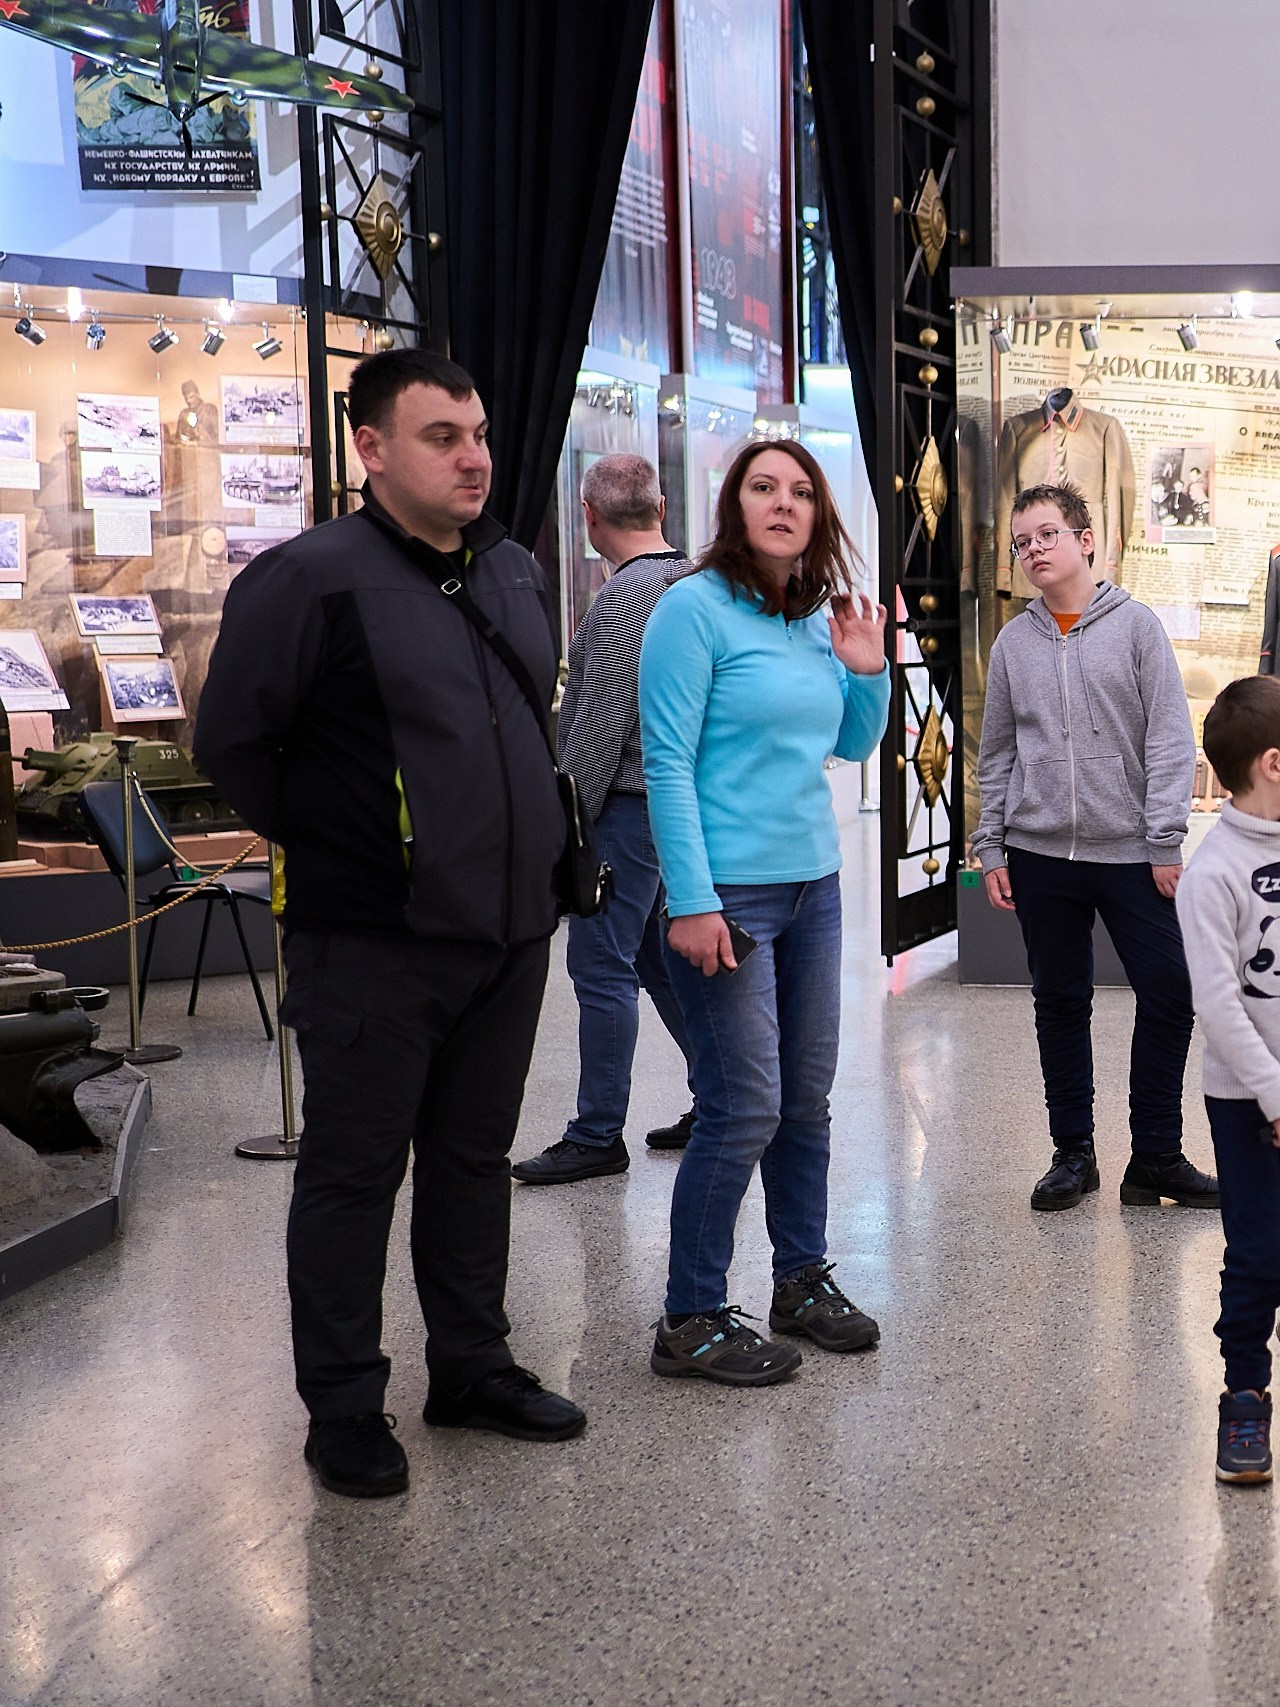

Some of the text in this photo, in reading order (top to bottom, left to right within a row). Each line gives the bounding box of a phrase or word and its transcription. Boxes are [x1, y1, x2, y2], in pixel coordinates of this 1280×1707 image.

[104, 161, 117, 170] ИХ
[188, 161, 201, 171] ИХ
[93, 173, 106, 182] ИХ
[154, 173, 199, 183] ПОРЯДКУ
[1102, 355, 1196, 382] КРАСНАЯ
[1199, 363, 1280, 390] ЗВЕЗДА
[1239, 426, 1248, 436] О
[159, 749, 179, 760] 325
